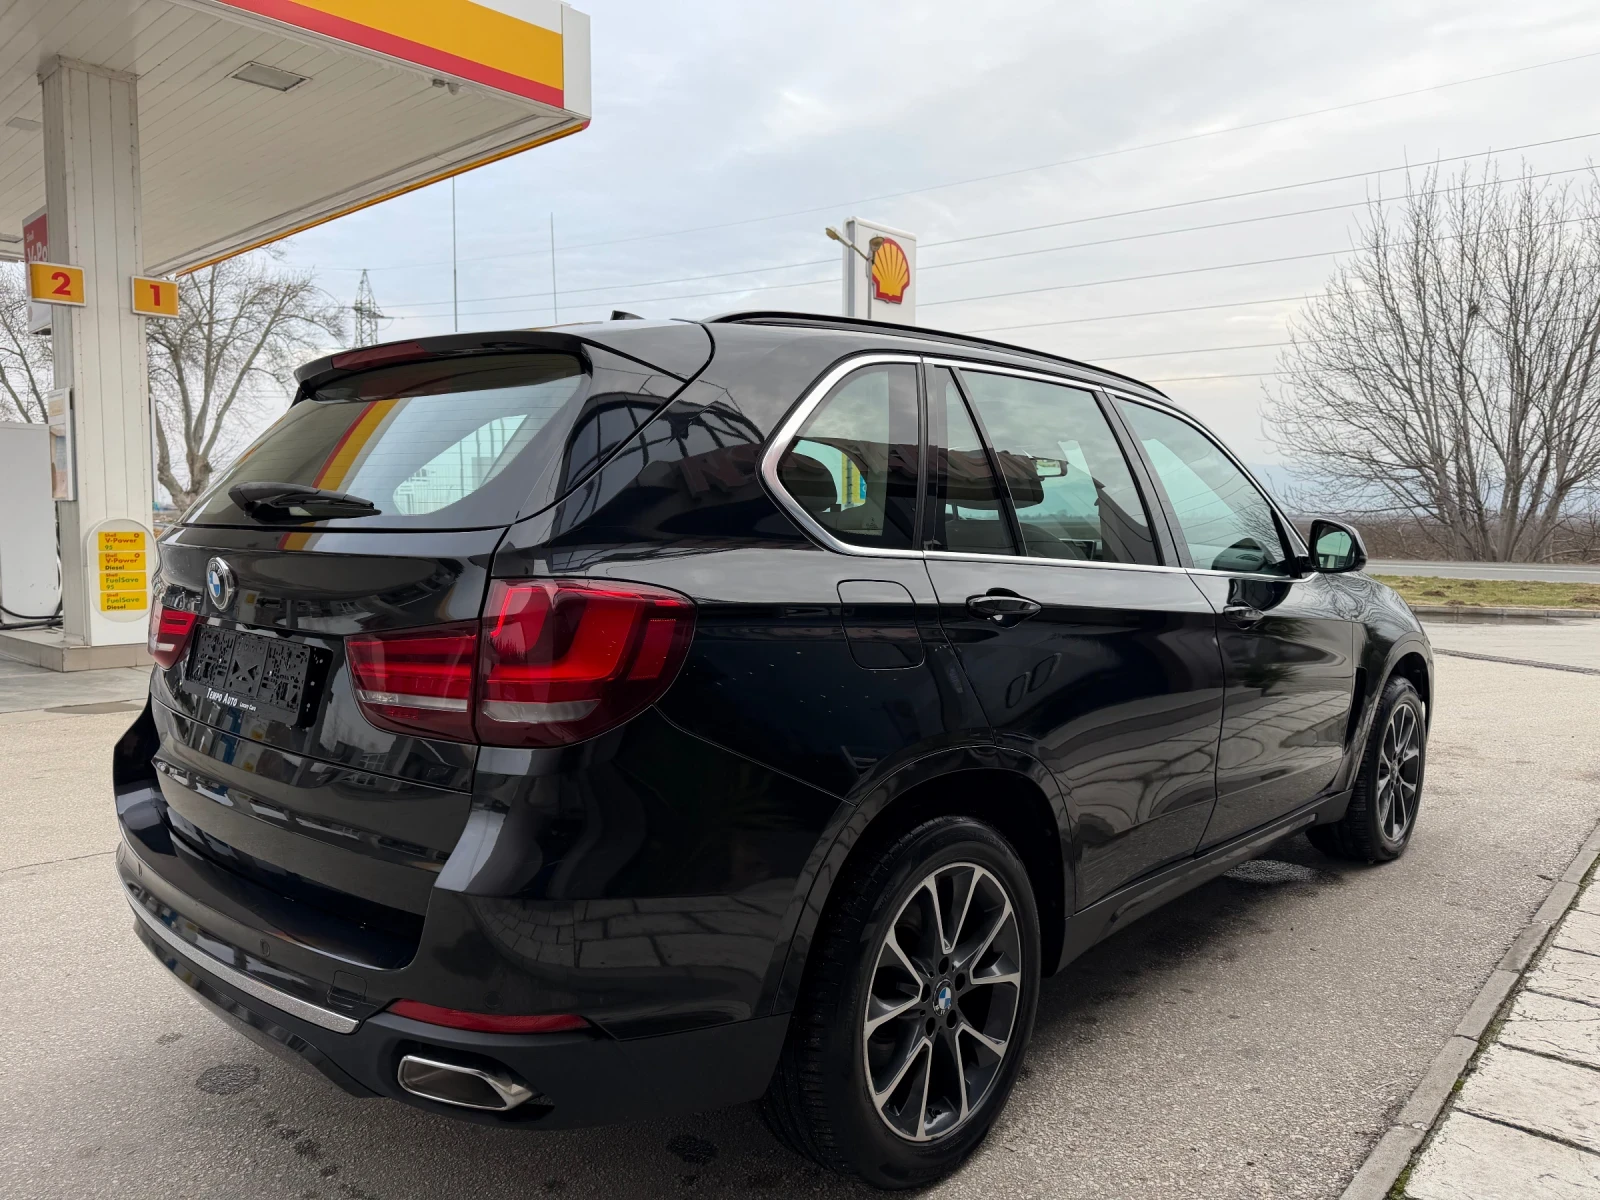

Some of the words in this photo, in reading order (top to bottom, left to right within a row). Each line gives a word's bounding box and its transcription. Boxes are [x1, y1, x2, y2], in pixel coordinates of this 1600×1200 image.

[51, 271, 72, 296] 2
[149, 284, 161, 307] 1
[222, 692, 238, 706] AUTO
